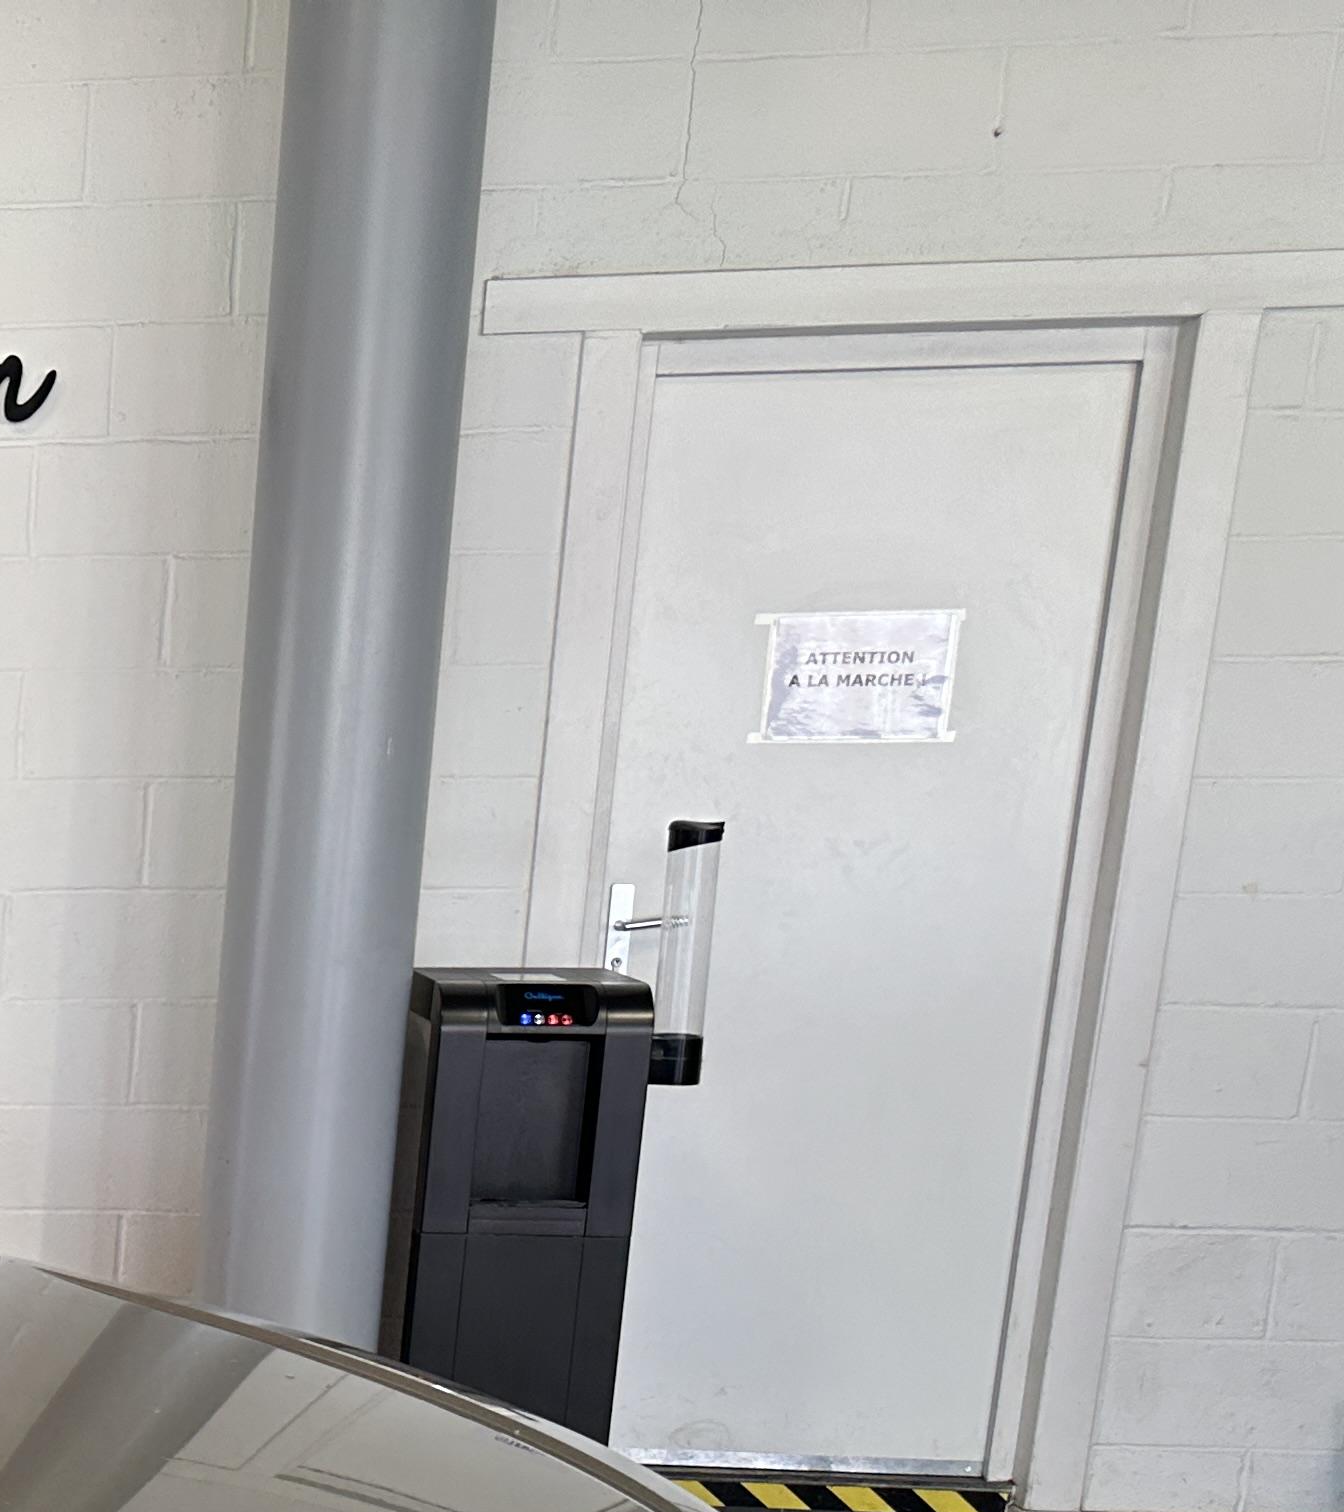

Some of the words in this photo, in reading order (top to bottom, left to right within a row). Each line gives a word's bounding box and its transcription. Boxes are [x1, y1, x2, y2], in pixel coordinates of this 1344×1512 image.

[805, 650, 915, 666] ATTENTION
[788, 674, 801, 688] A
[807, 673, 830, 688] LA
[836, 672, 914, 687] MARCHE
